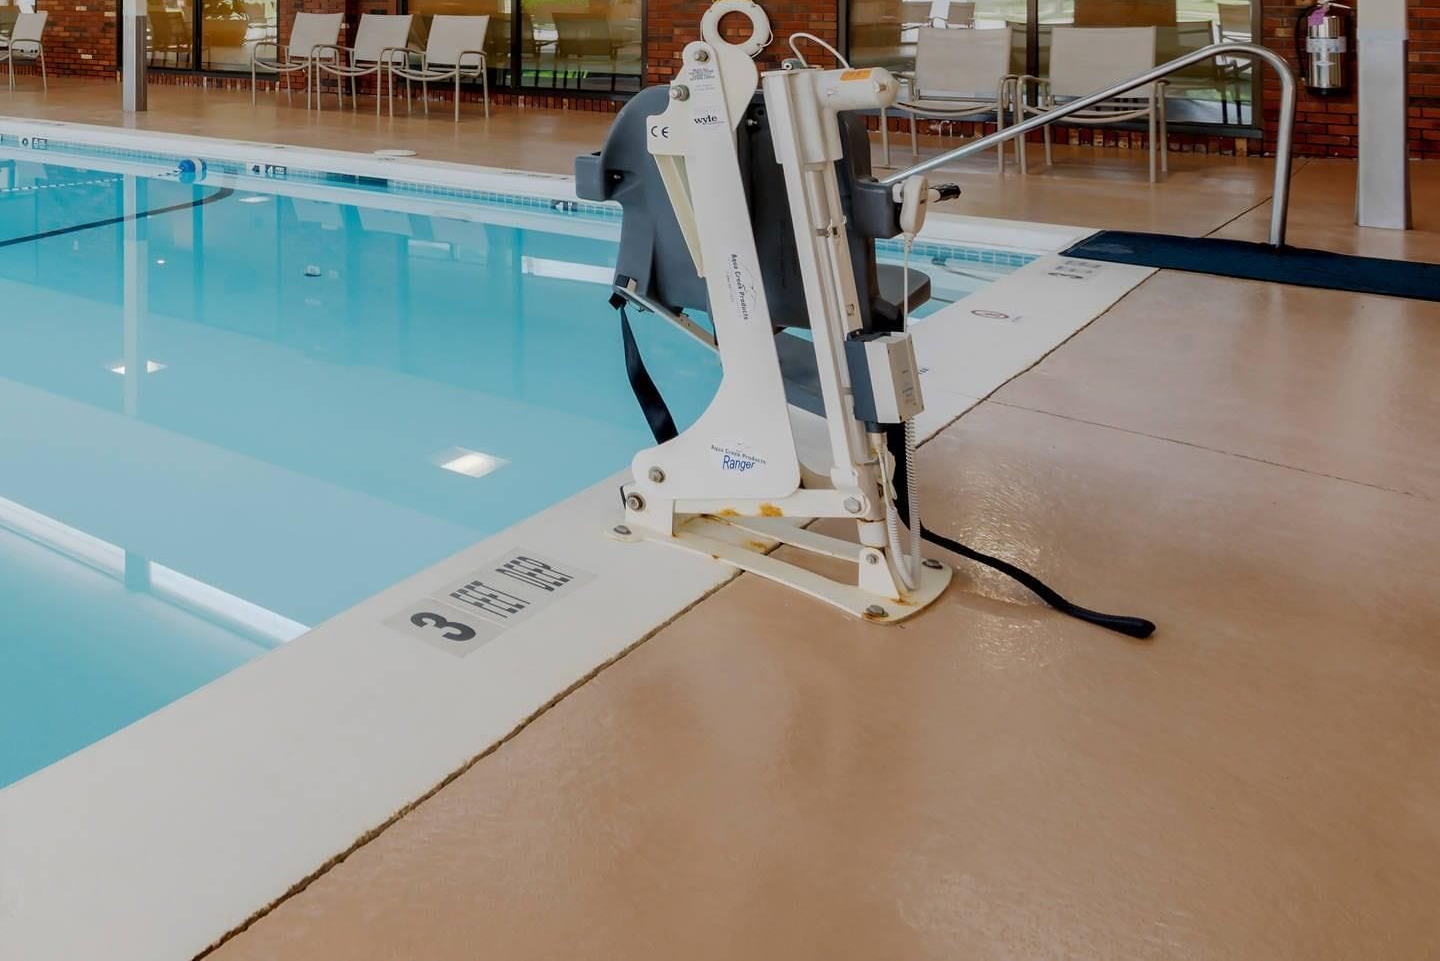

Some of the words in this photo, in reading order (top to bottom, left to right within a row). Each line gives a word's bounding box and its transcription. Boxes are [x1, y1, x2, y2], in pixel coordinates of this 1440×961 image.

[694, 115, 718, 125] wyle
[651, 126, 669, 138] CE
[723, 455, 755, 472] Ranger
[449, 580, 531, 618] FEET
[495, 556, 574, 592] DEEP
[410, 612, 476, 642] 3
